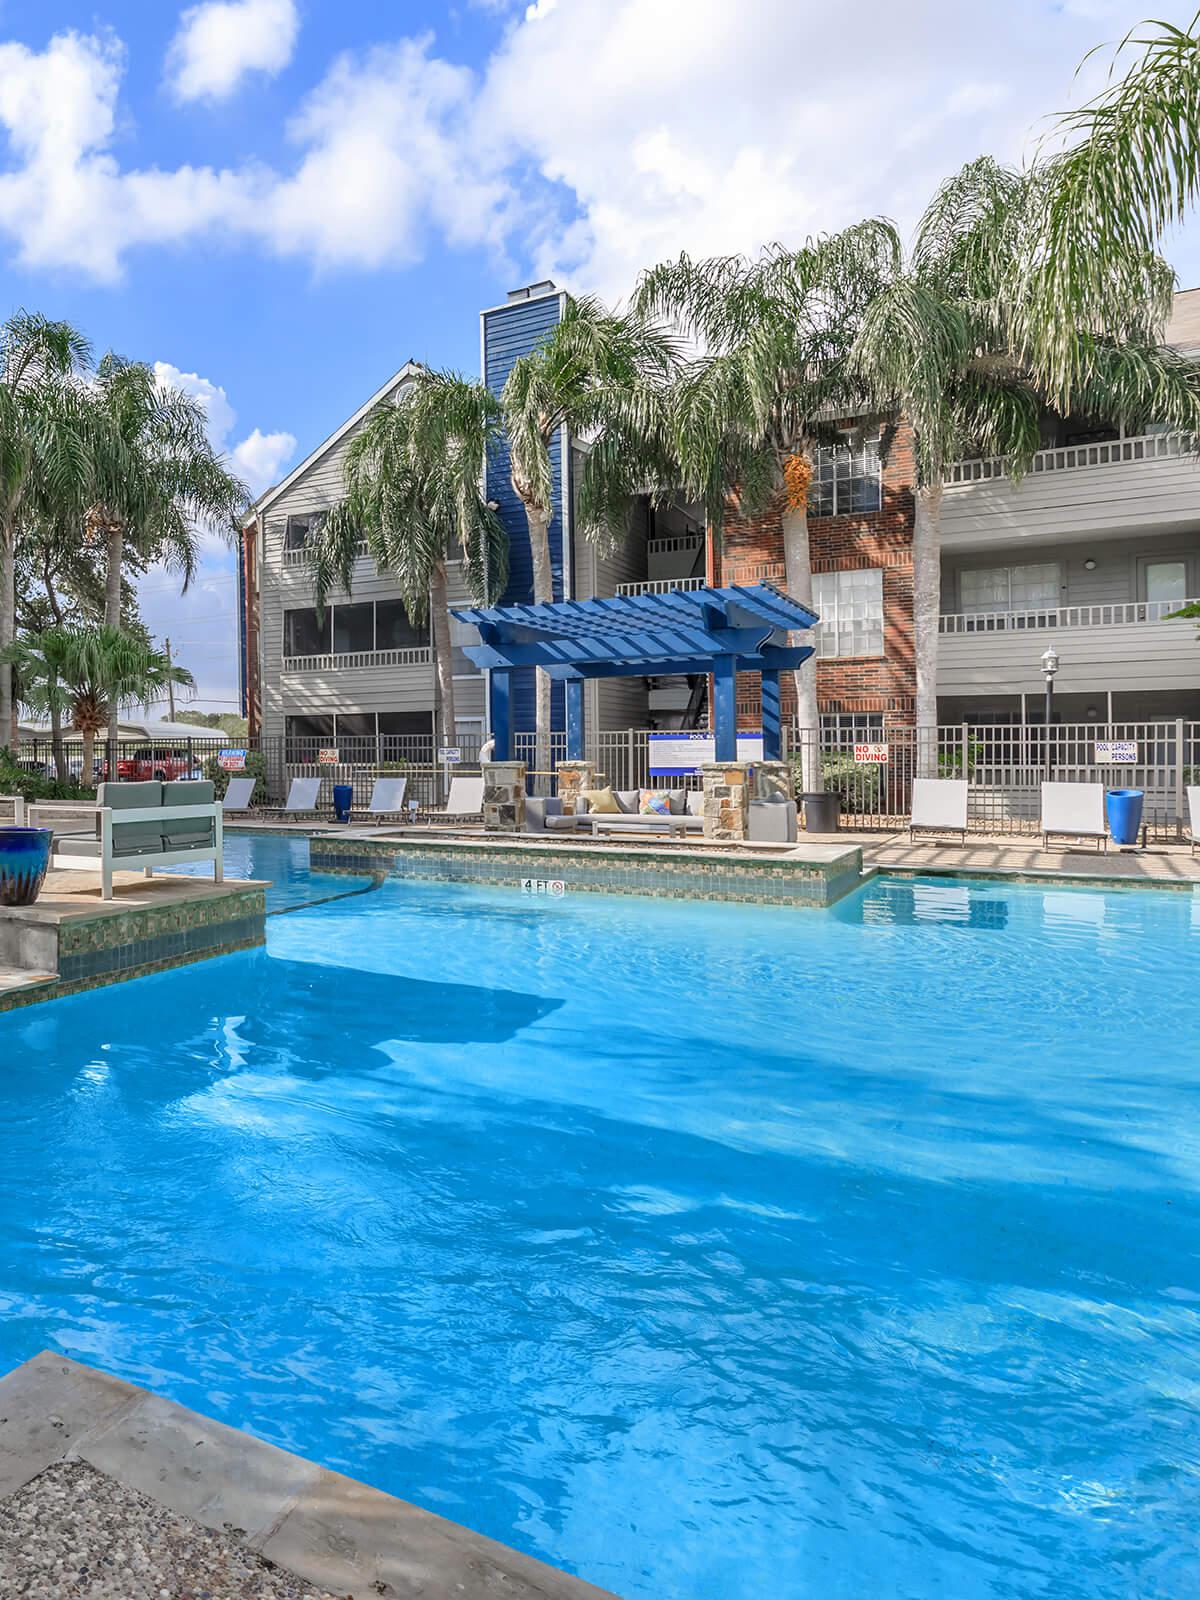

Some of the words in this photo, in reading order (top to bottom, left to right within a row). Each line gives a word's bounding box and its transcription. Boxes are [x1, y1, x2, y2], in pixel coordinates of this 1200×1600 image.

[856, 745, 869, 753] NO
[1096, 743, 1109, 751] POOL
[1112, 743, 1135, 751] CAPACITY
[856, 753, 887, 761] DIVING
[1112, 753, 1136, 761] PERSONS
[525, 880, 532, 888] 4
[537, 880, 549, 889] FT
